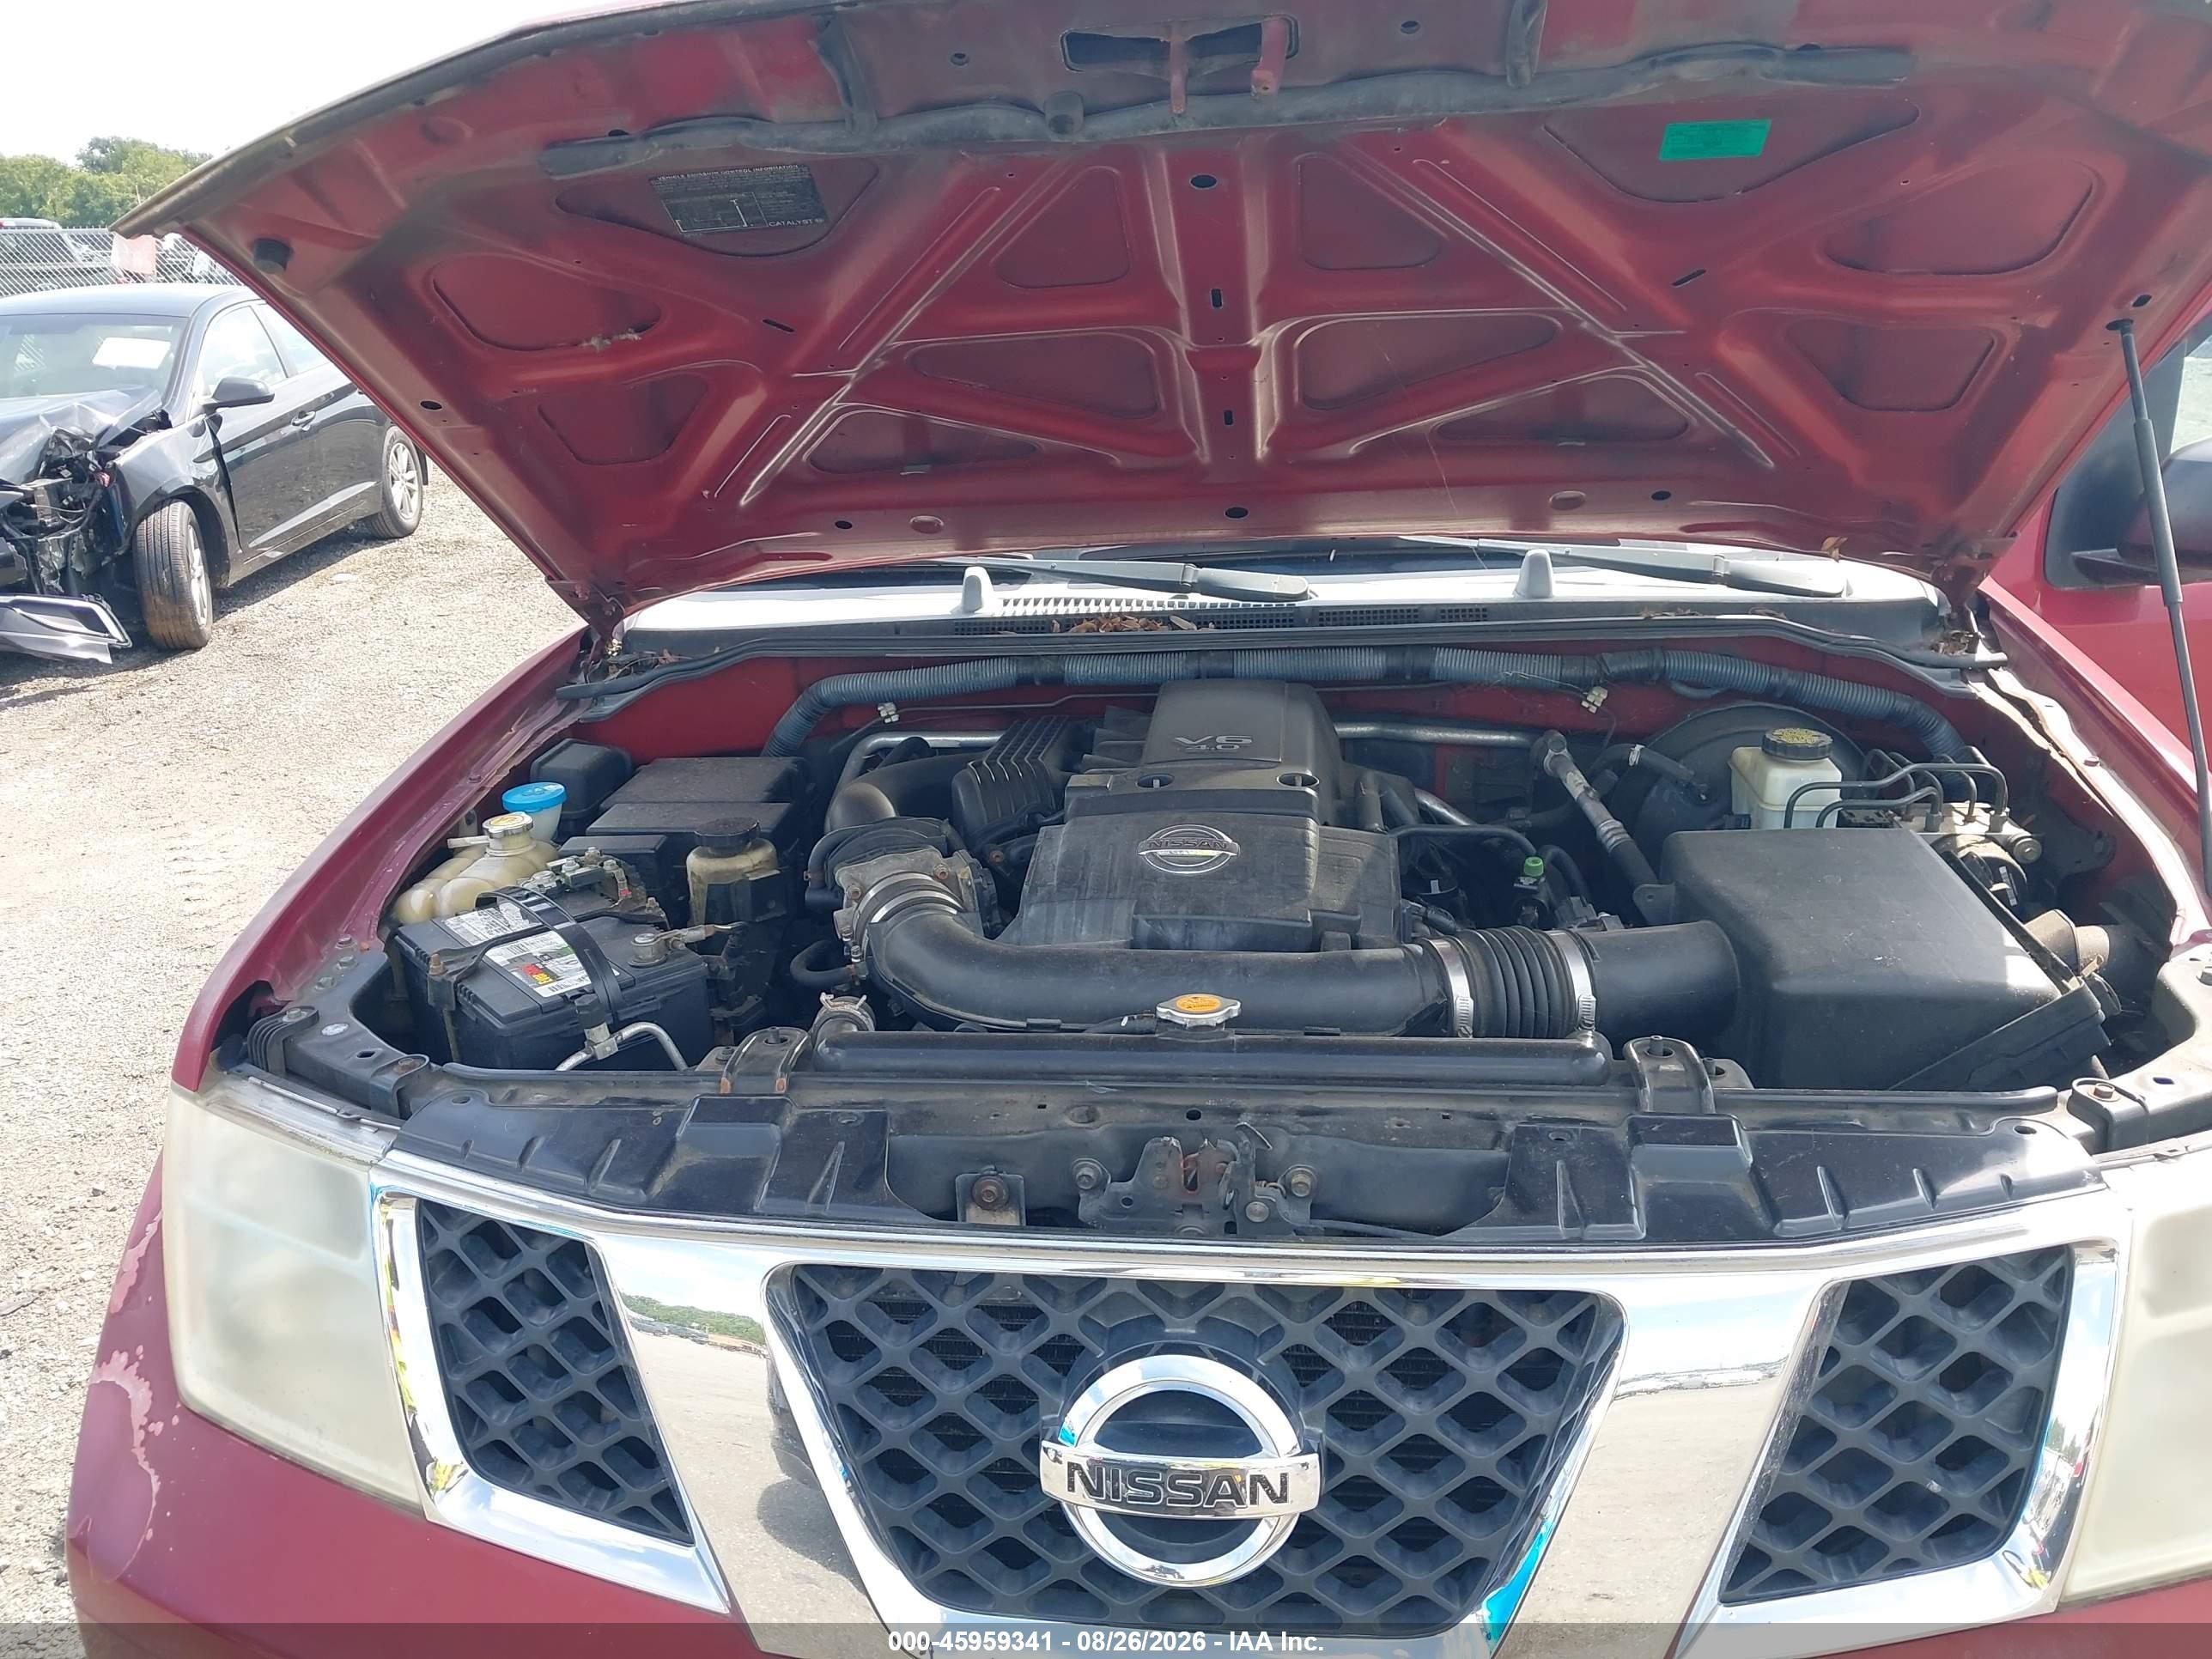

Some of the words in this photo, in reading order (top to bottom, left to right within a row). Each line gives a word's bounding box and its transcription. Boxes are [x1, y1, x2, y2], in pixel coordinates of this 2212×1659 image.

[658, 173, 685, 182] VEHICLE
[687, 170, 719, 179] EMISSION
[753, 164, 799, 173] INFORMATION
[769, 218, 813, 227] CATALYST
[1174, 734, 1253, 745] V6
[1150, 838, 1227, 850] NISSAN
[1066, 1461, 1290, 1509] NISSAN
